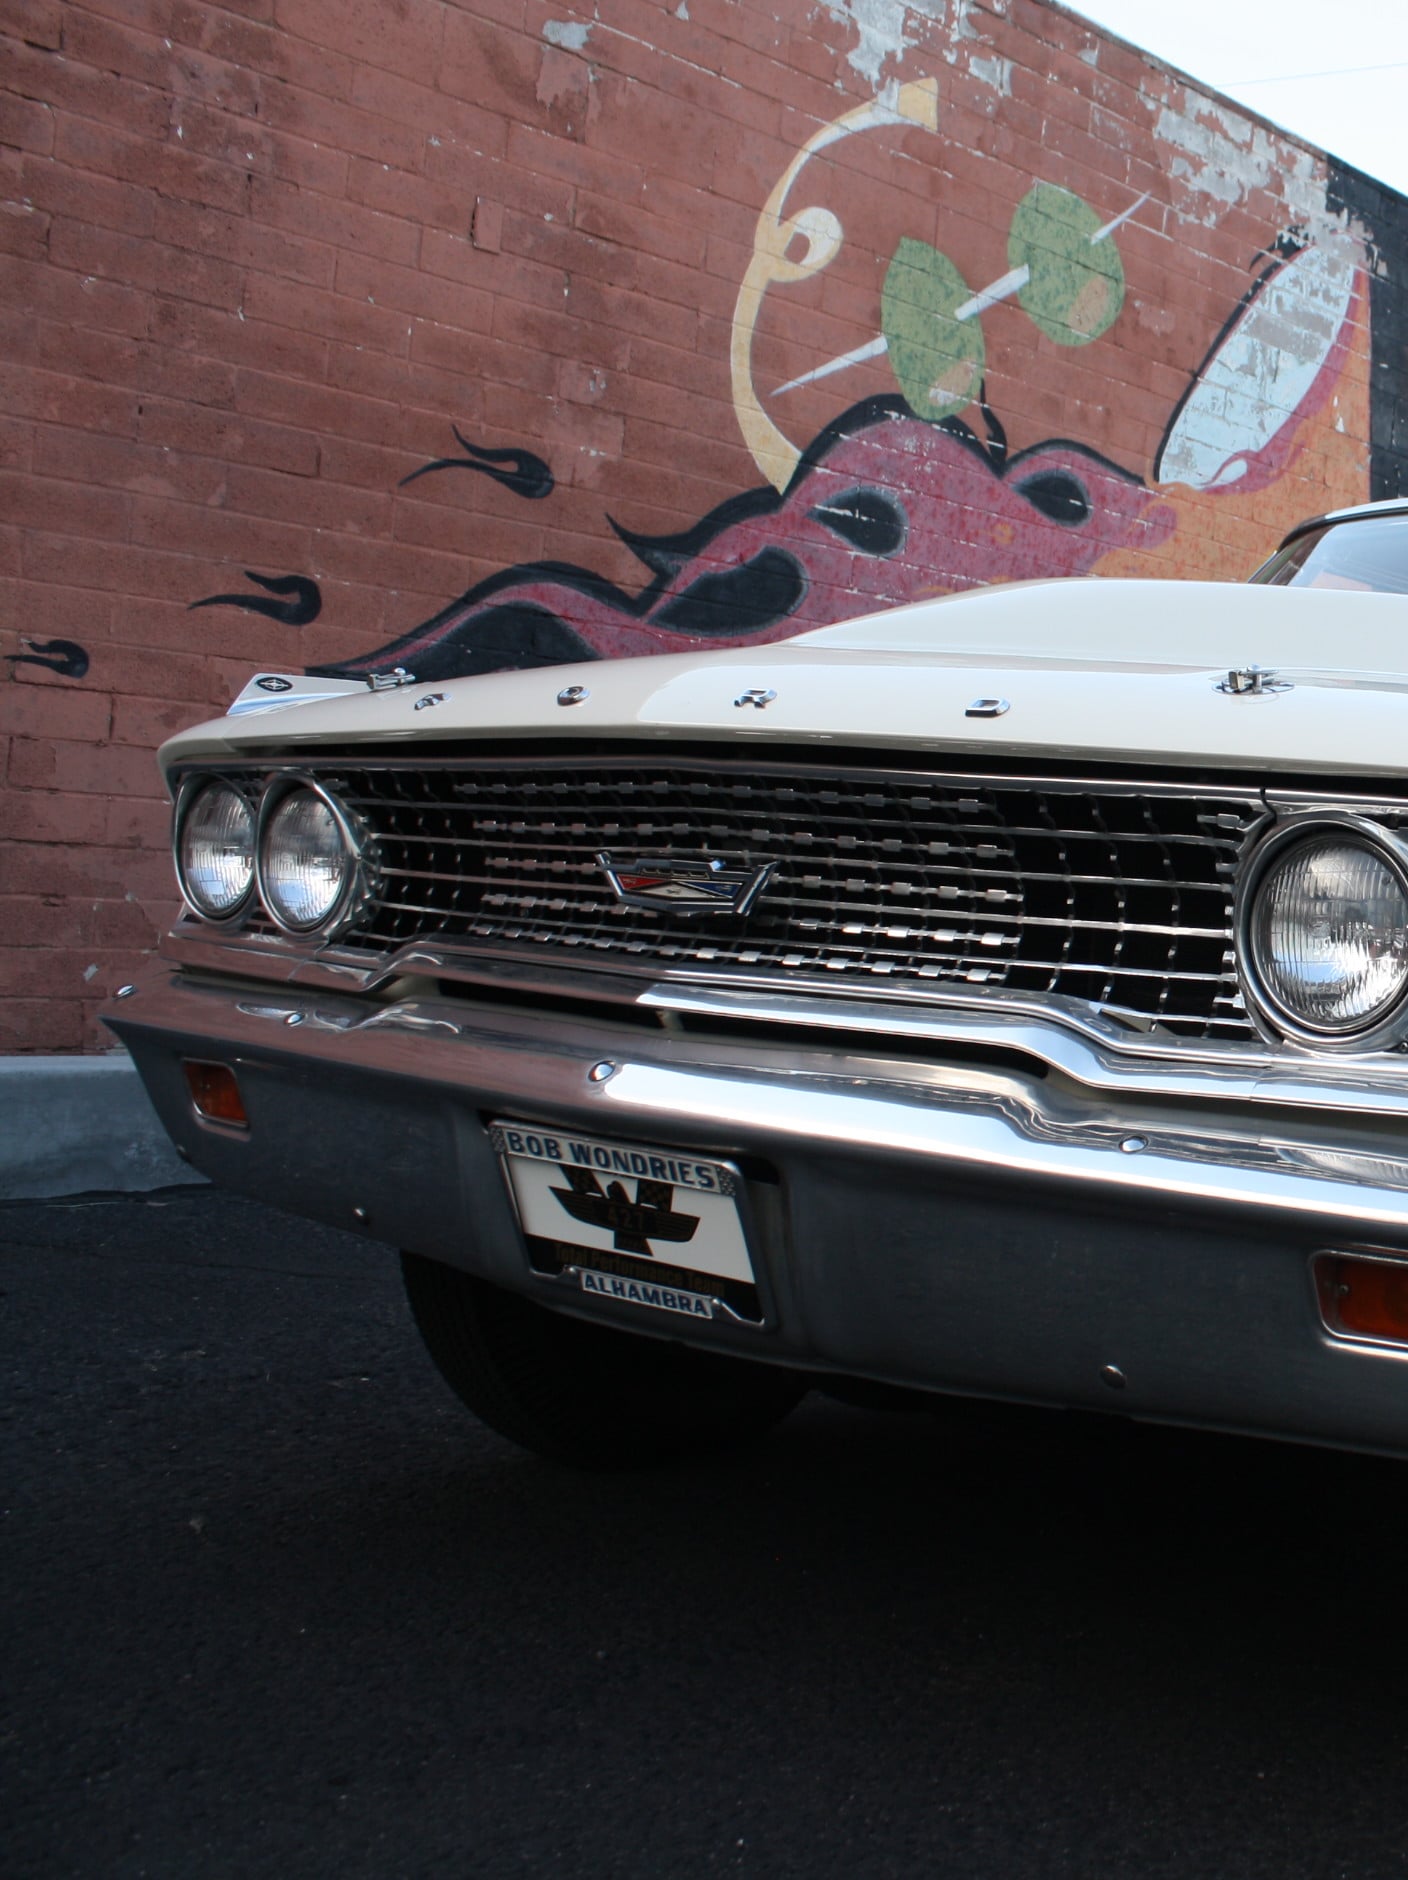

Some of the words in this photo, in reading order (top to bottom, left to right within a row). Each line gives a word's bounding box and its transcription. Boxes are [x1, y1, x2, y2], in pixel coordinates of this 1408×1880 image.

[506, 1131, 563, 1161] BOB
[568, 1141, 716, 1189] WONDRIES
[584, 1274, 710, 1317] ALHAMBRA
